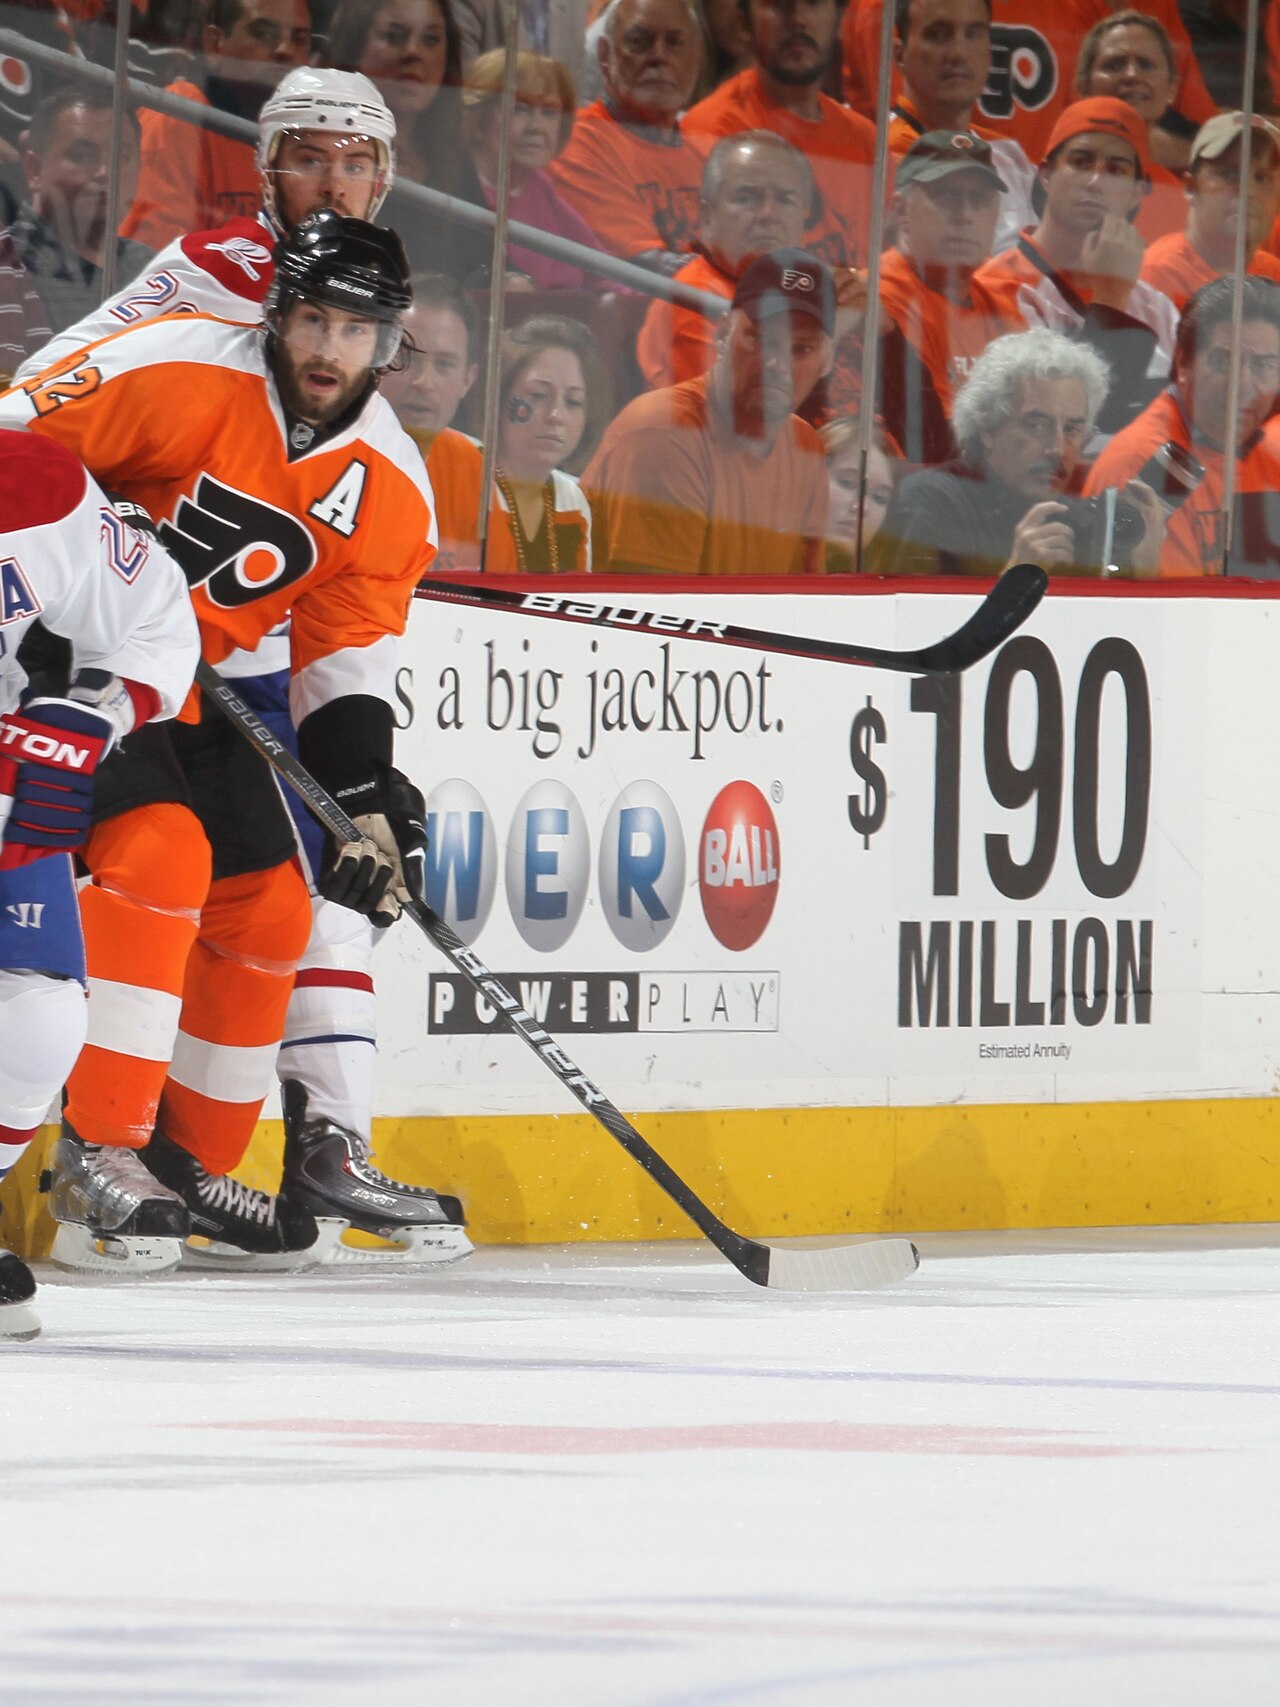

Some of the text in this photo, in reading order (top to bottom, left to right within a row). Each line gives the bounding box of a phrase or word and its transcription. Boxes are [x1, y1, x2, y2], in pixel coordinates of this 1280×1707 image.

[326, 277, 375, 299] BAUER
[306, 457, 367, 540] A
[519, 593, 728, 639] BAUER
[216, 686, 285, 756] BAUER
[436, 666, 465, 731] a
[483, 638, 564, 760] big
[577, 639, 785, 760] jackpot.
[424, 805, 779, 922] WER BALL
[897, 916, 1154, 1028] MILLION
[979, 1043, 1073, 1060] Estimated Annuity
